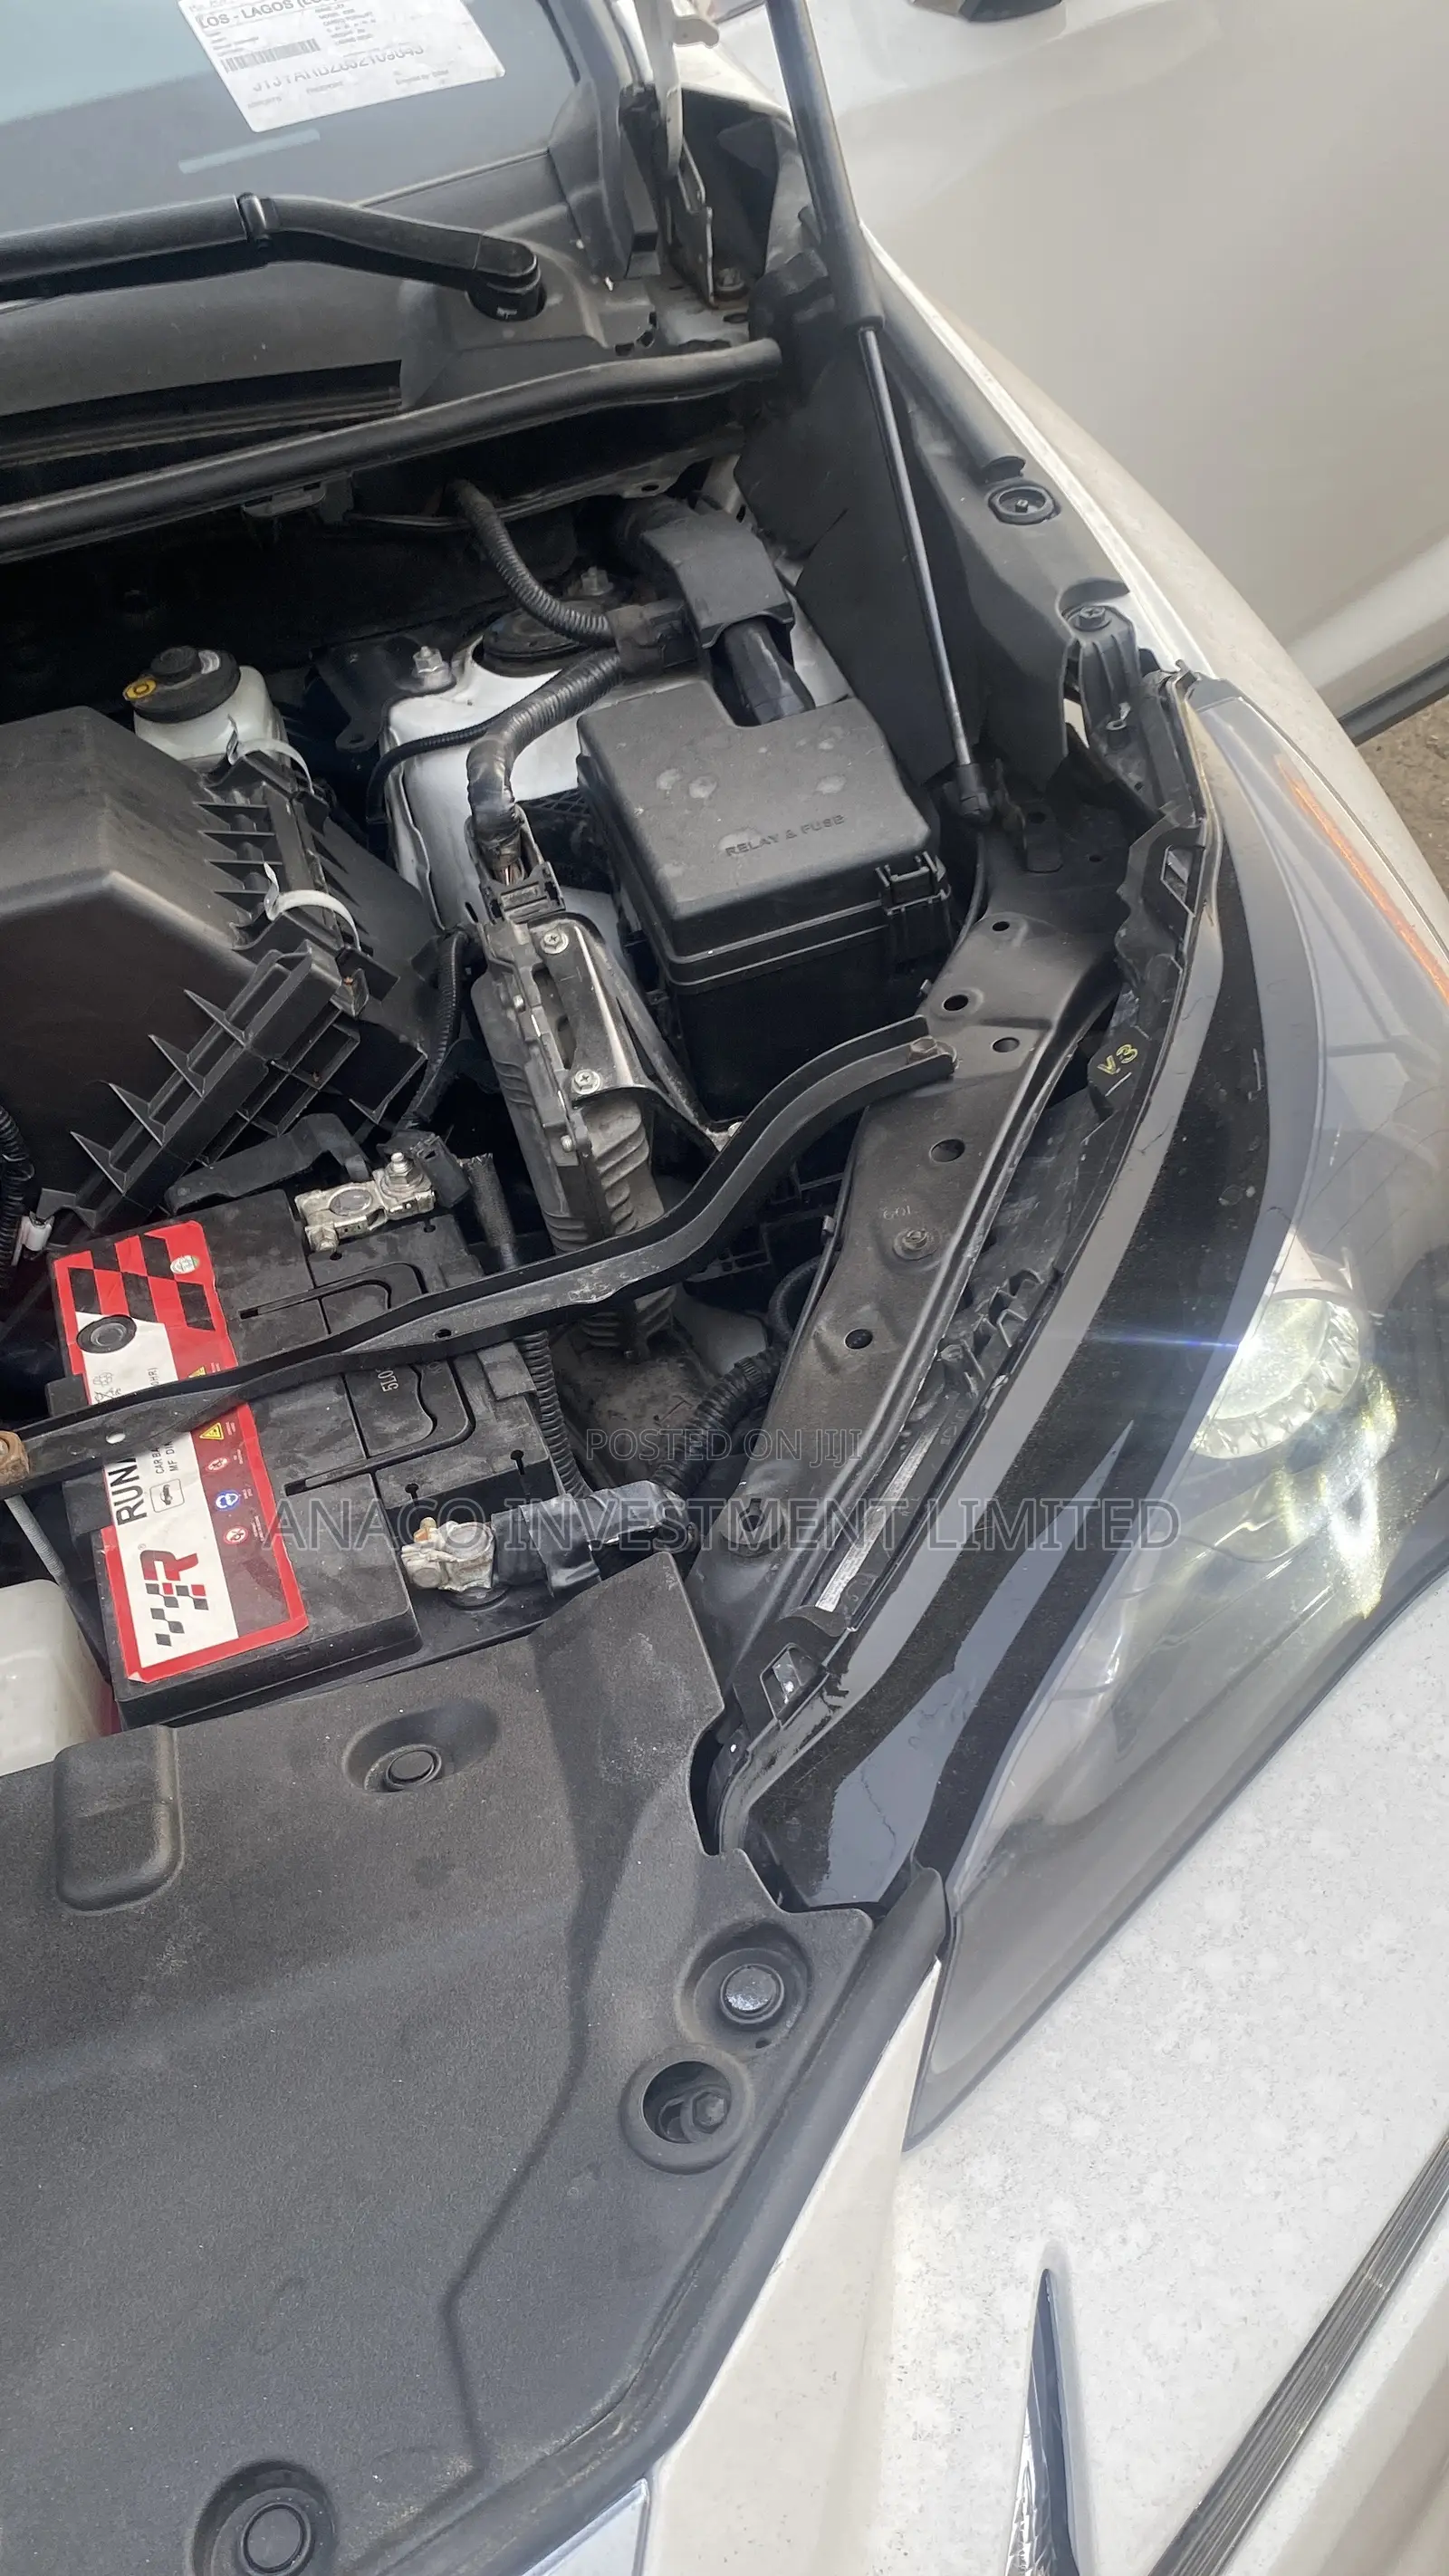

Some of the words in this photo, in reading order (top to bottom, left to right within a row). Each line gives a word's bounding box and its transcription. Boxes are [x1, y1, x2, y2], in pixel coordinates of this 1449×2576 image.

[197, 13, 230, 29] LOS
[241, 0, 294, 19] LAGOS
[724, 833, 779, 856] RELAY
[785, 829, 797, 840] &
[800, 814, 845, 834] FUSE
[152, 1458, 165, 1475] CAR
[167, 1459, 179, 1472] MF
